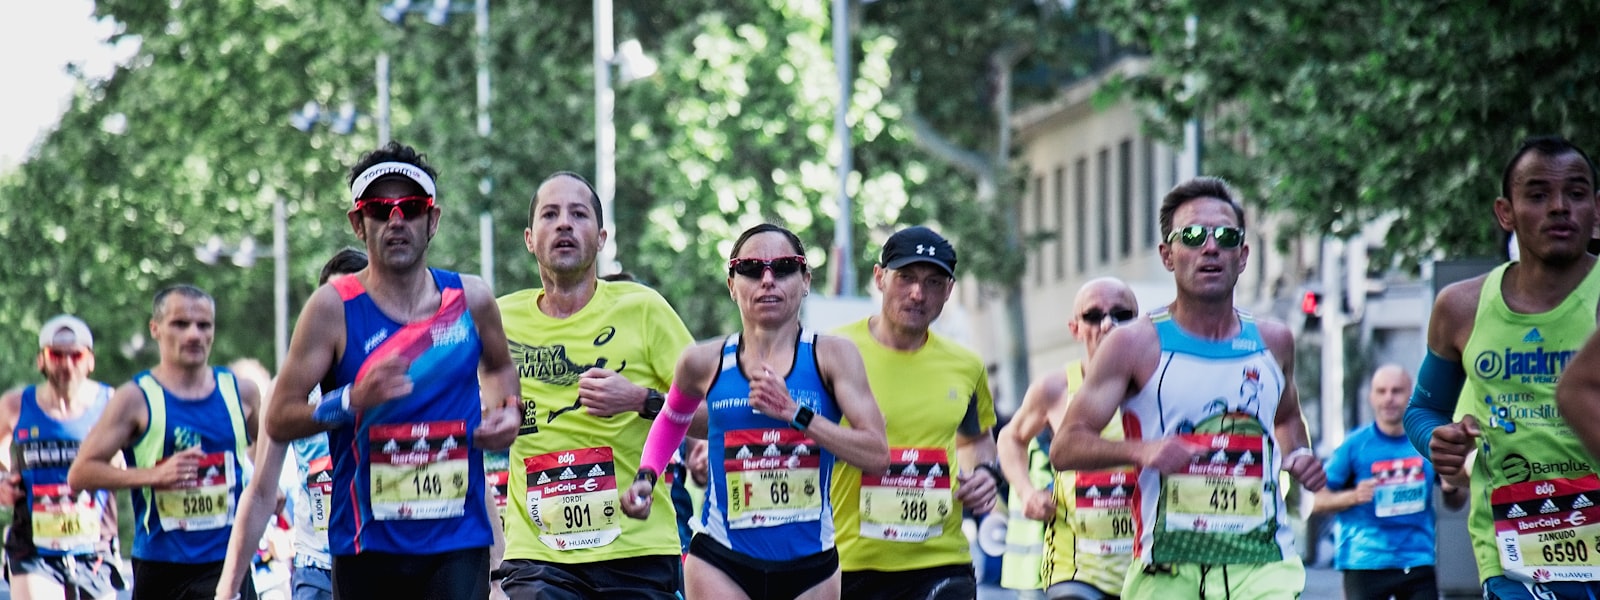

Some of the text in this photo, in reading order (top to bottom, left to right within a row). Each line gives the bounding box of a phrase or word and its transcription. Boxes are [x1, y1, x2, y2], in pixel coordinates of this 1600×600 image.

[518, 360, 567, 378] MAD
[557, 452, 575, 465] edp
[1531, 459, 1591, 475] Banplus
[744, 482, 790, 506] F 68
[1535, 482, 1556, 496] edp
[183, 496, 213, 515] 5280
[562, 495, 582, 504] JORDI
[1210, 487, 1237, 511] 431
[563, 503, 592, 529] 901
[900, 500, 928, 521] 388
[569, 537, 601, 546] HUAWEI
[1538, 530, 1576, 542] ZANCUDO
[1542, 540, 1588, 562] 6590
